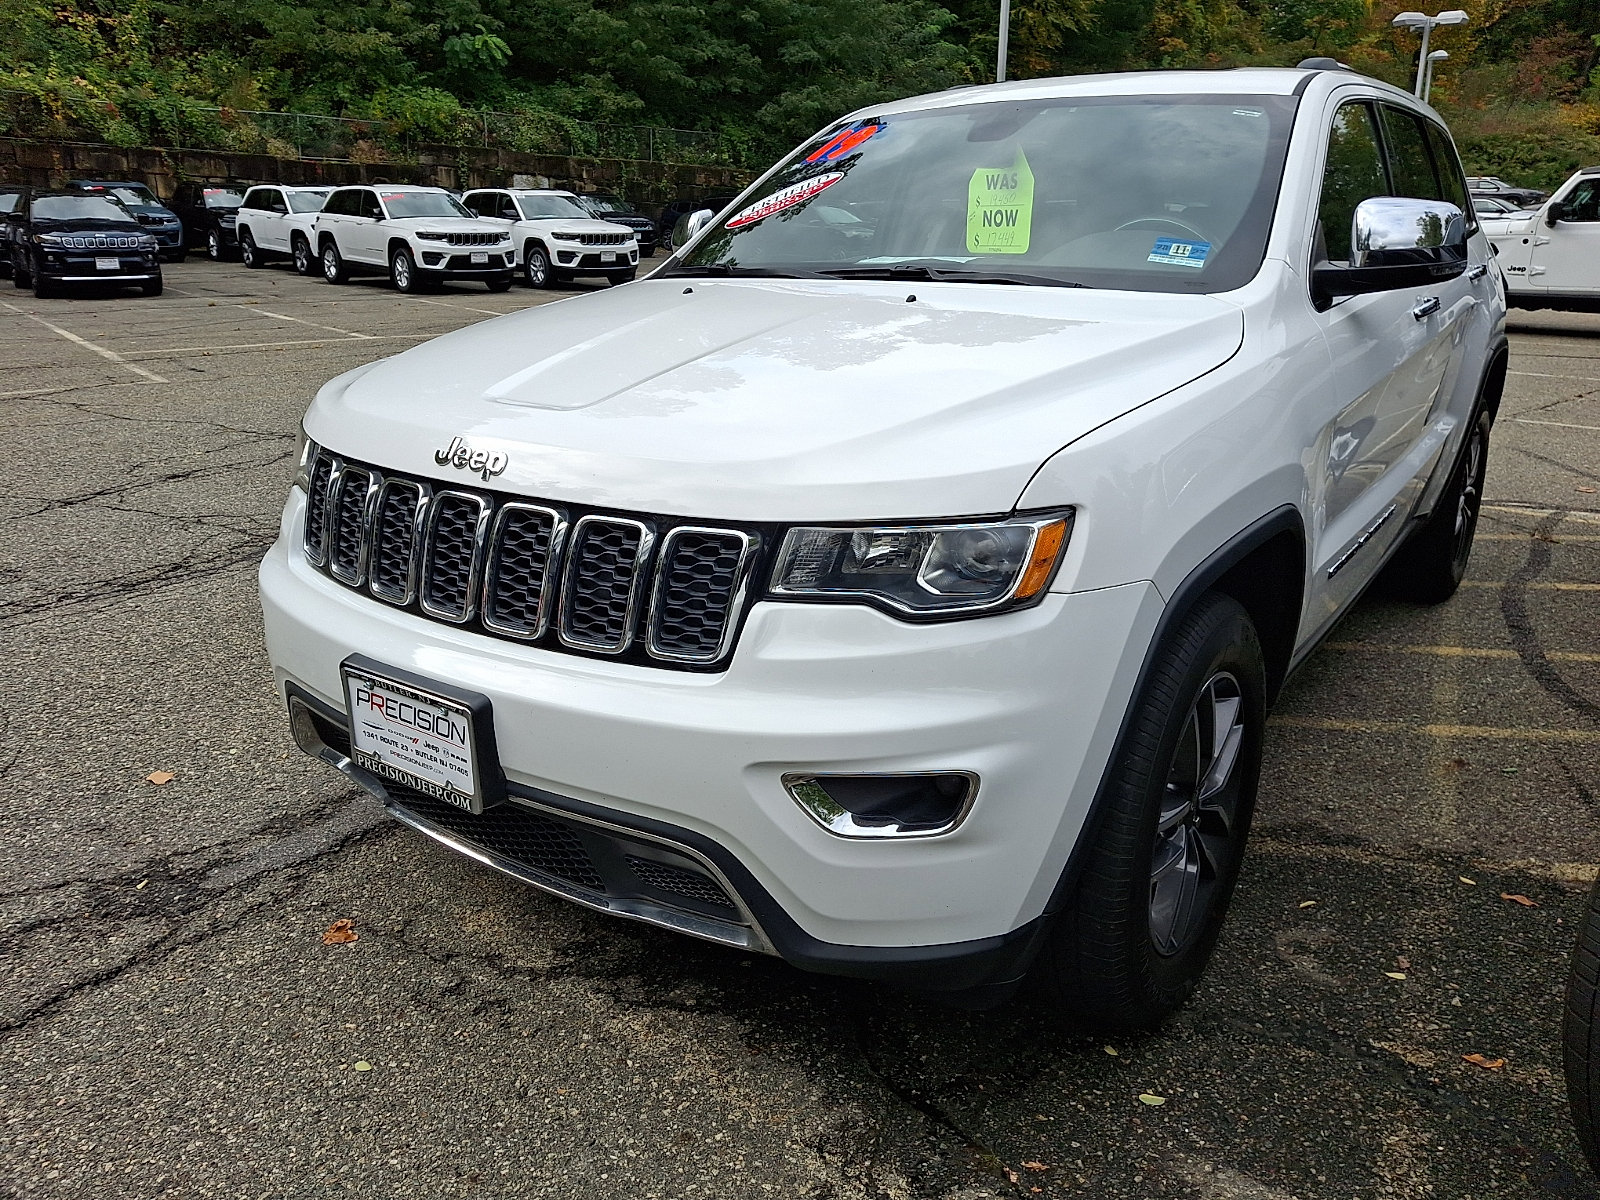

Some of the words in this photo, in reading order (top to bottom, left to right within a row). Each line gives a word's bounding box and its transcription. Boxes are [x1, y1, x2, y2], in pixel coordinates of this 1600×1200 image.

[985, 172, 1018, 191] WAS
[982, 208, 1019, 228] NOW
[1507, 264, 1527, 273] Jeep
[434, 436, 508, 482] Jeep
[356, 687, 466, 745] PRECISION
[356, 753, 472, 812] PRECISIONJEEP.COM
